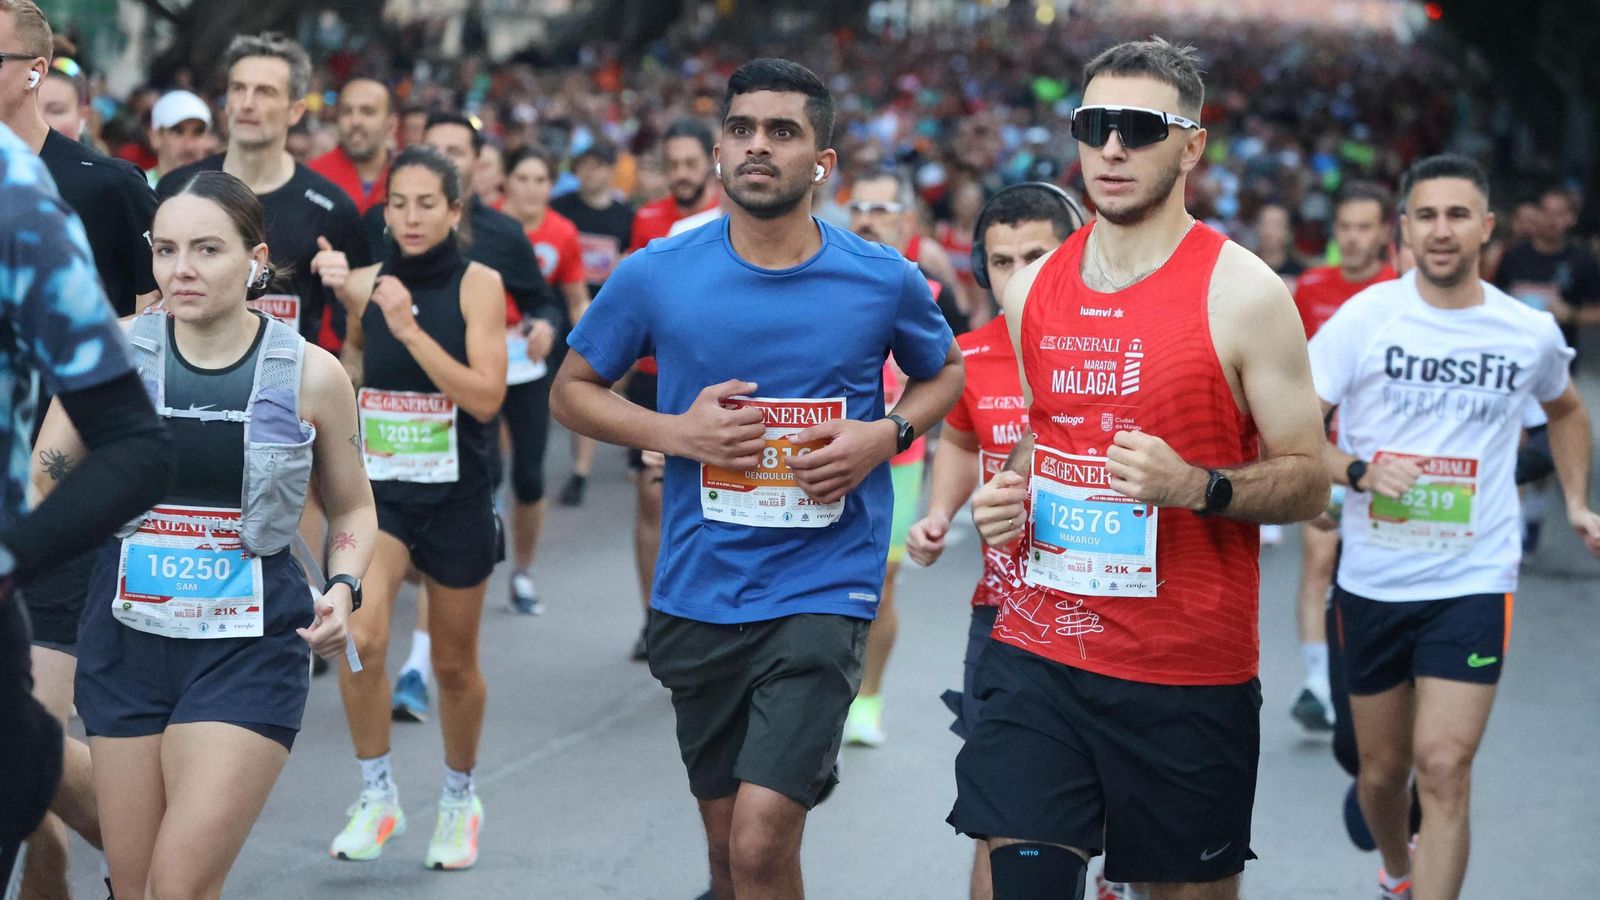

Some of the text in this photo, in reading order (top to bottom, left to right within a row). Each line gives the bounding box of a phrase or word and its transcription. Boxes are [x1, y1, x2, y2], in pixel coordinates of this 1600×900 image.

[1080, 306, 1112, 317] luanvi
[1057, 336, 1121, 353] GENERALI
[1083, 359, 1118, 371] MARATÓN
[1384, 345, 1521, 391] CrossFit
[1051, 366, 1118, 396] MÁLAGA
[378, 423, 433, 443] 12012
[1050, 502, 1121, 535] 12576
[1060, 532, 1101, 545] MAKAROV
[147, 554, 231, 580] 16250
[1105, 565, 1129, 574] 21K
[176, 582, 198, 592] SAM
[215, 607, 238, 616] 21K
